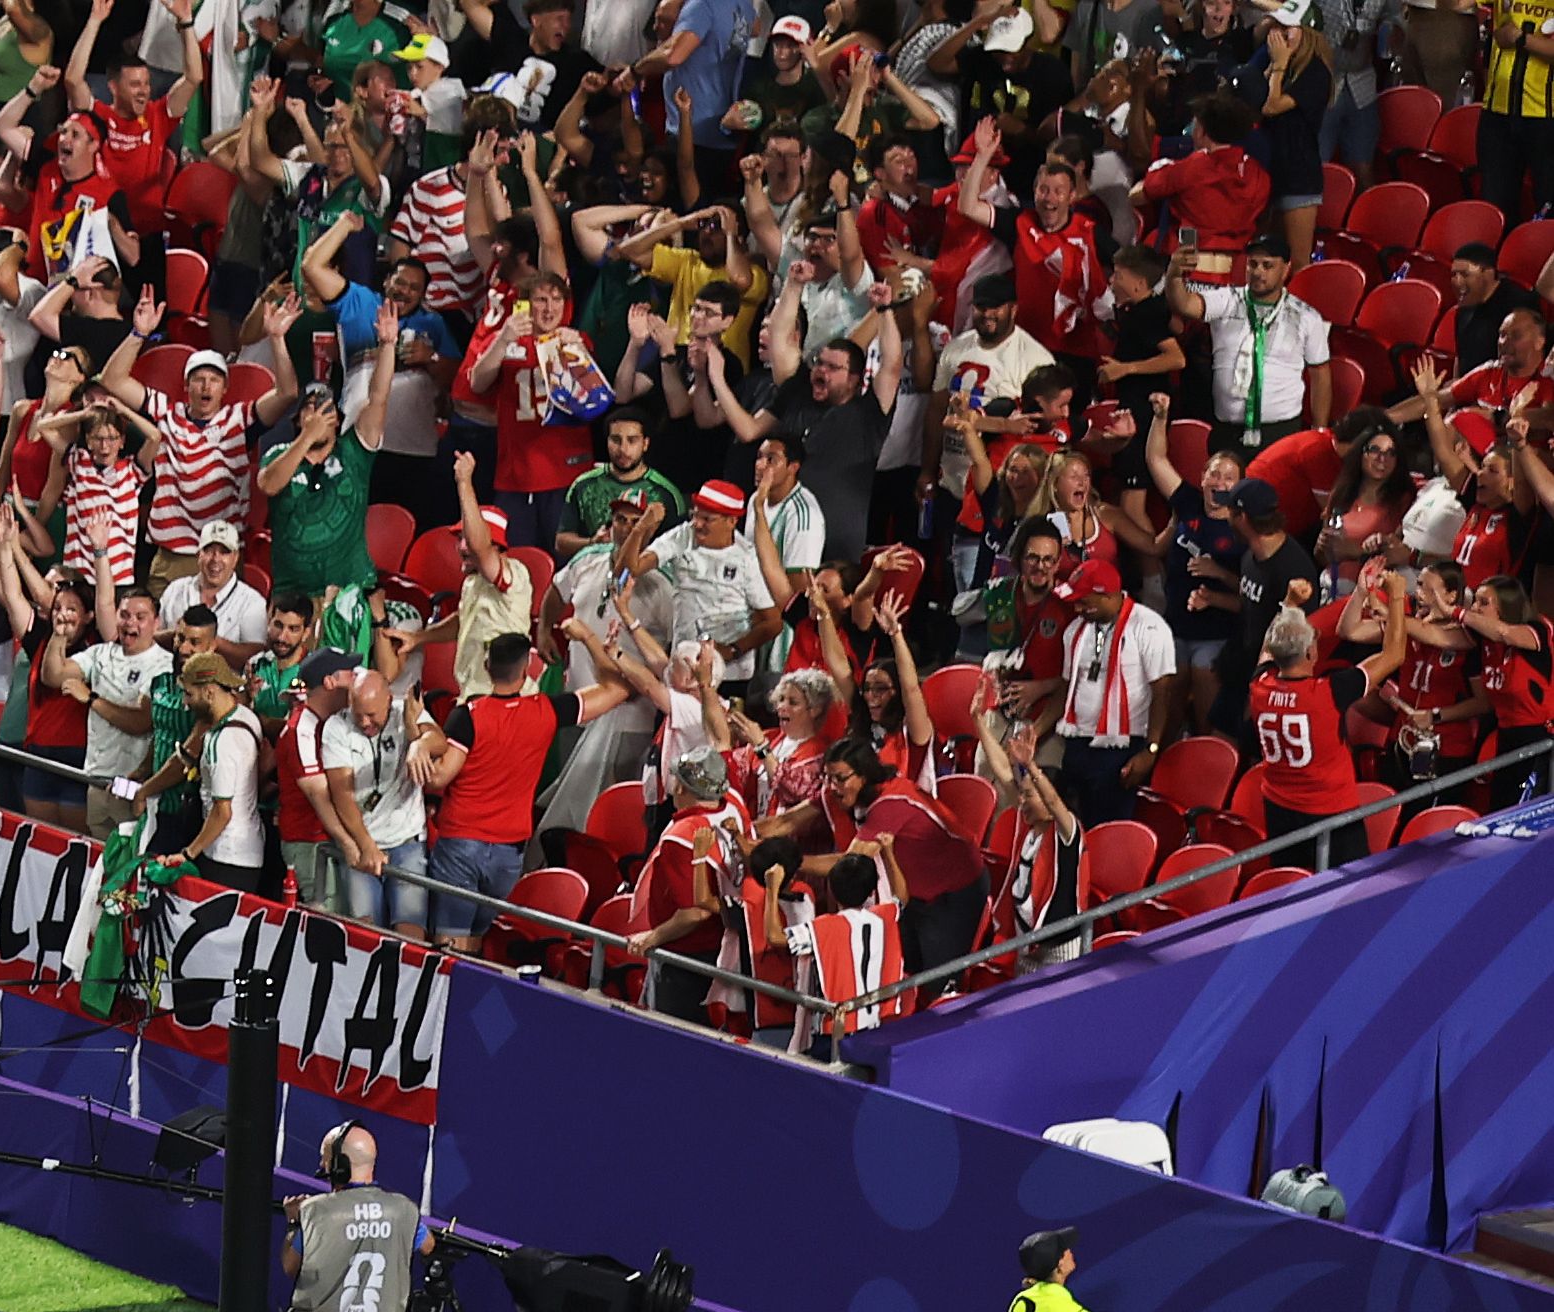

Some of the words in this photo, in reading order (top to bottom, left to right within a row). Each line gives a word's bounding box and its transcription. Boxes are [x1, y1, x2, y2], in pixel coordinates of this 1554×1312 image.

[1257, 712, 1312, 768] 69
[354, 1203, 383, 1221] HB
[346, 1221, 391, 1240] 0800
